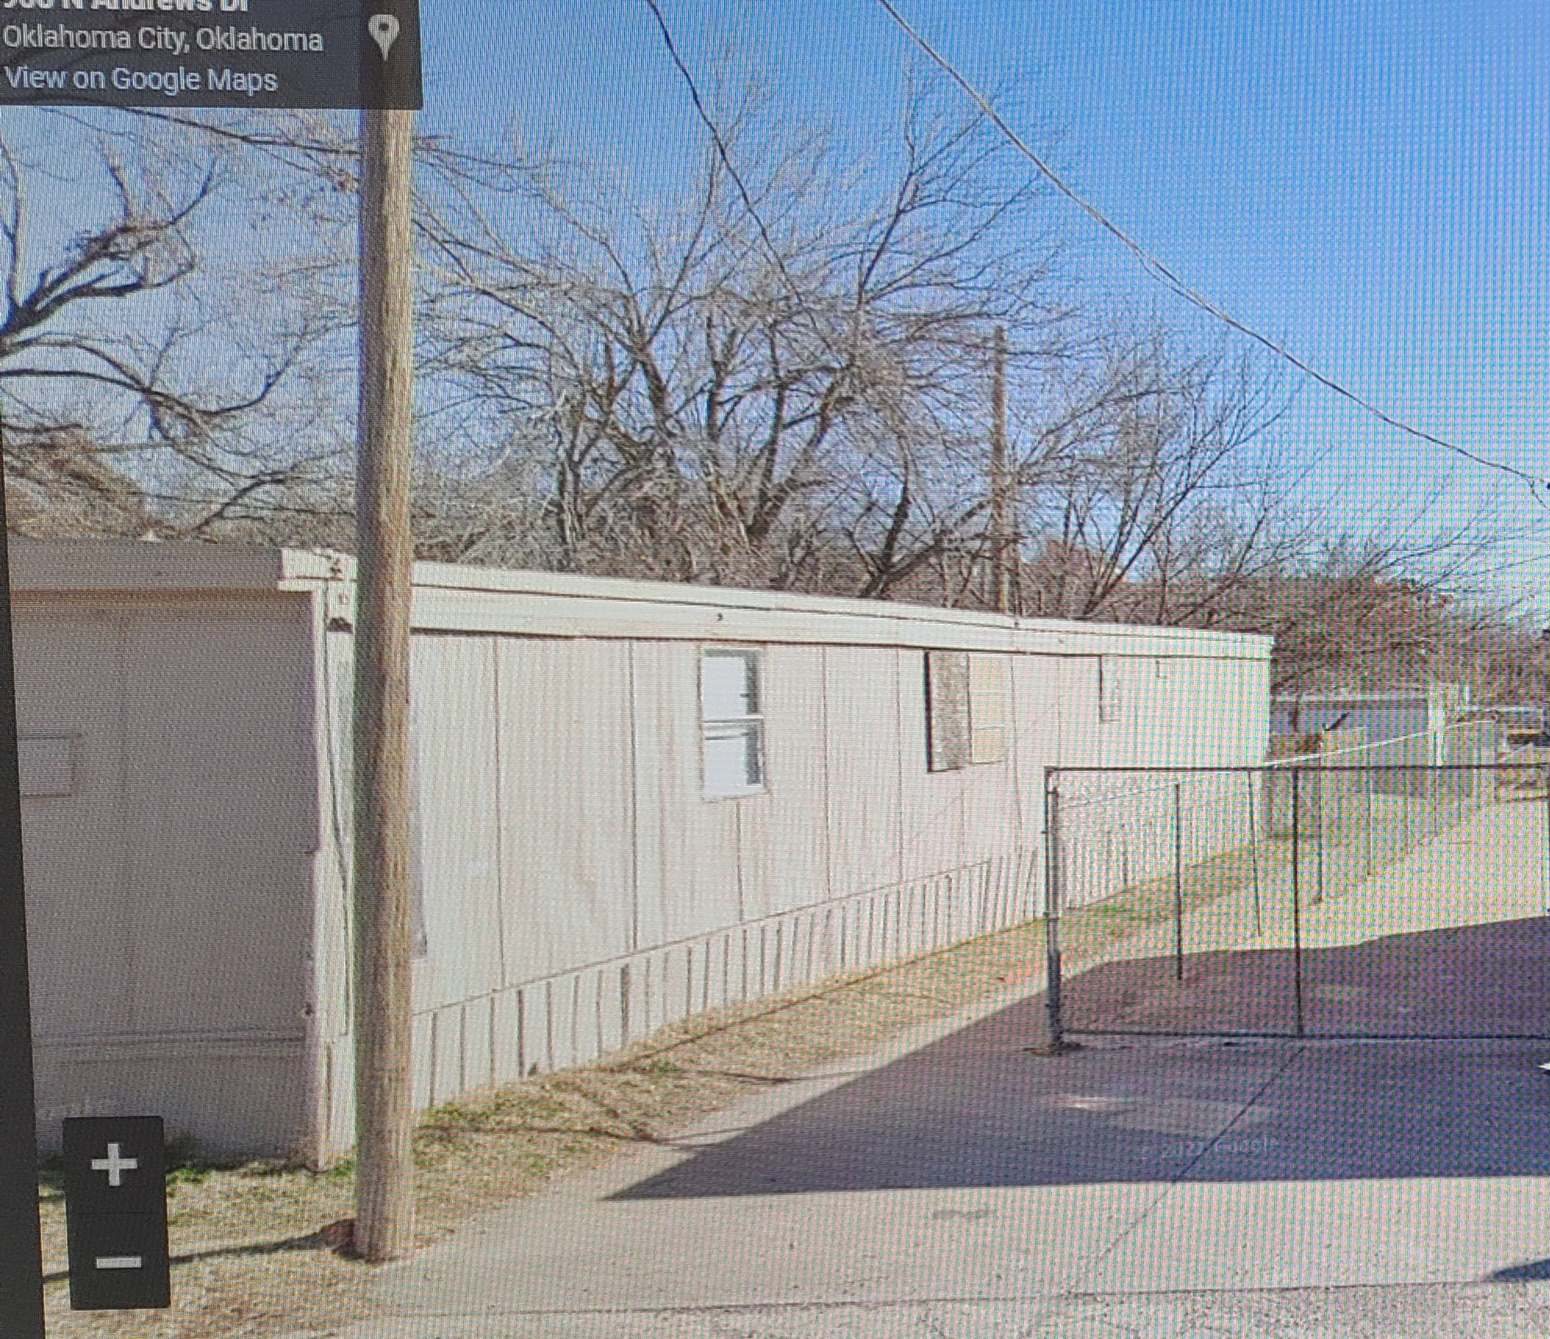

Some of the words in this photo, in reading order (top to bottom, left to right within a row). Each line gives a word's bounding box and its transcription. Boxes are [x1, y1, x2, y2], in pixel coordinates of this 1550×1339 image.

[3, 23, 130, 48] Oklahoma
[138, 25, 190, 54] City,
[196, 26, 324, 52] Oklahoma
[5, 66, 67, 88] View
[73, 71, 106, 88] on
[112, 67, 200, 96] Google
[208, 69, 278, 96] Maps
